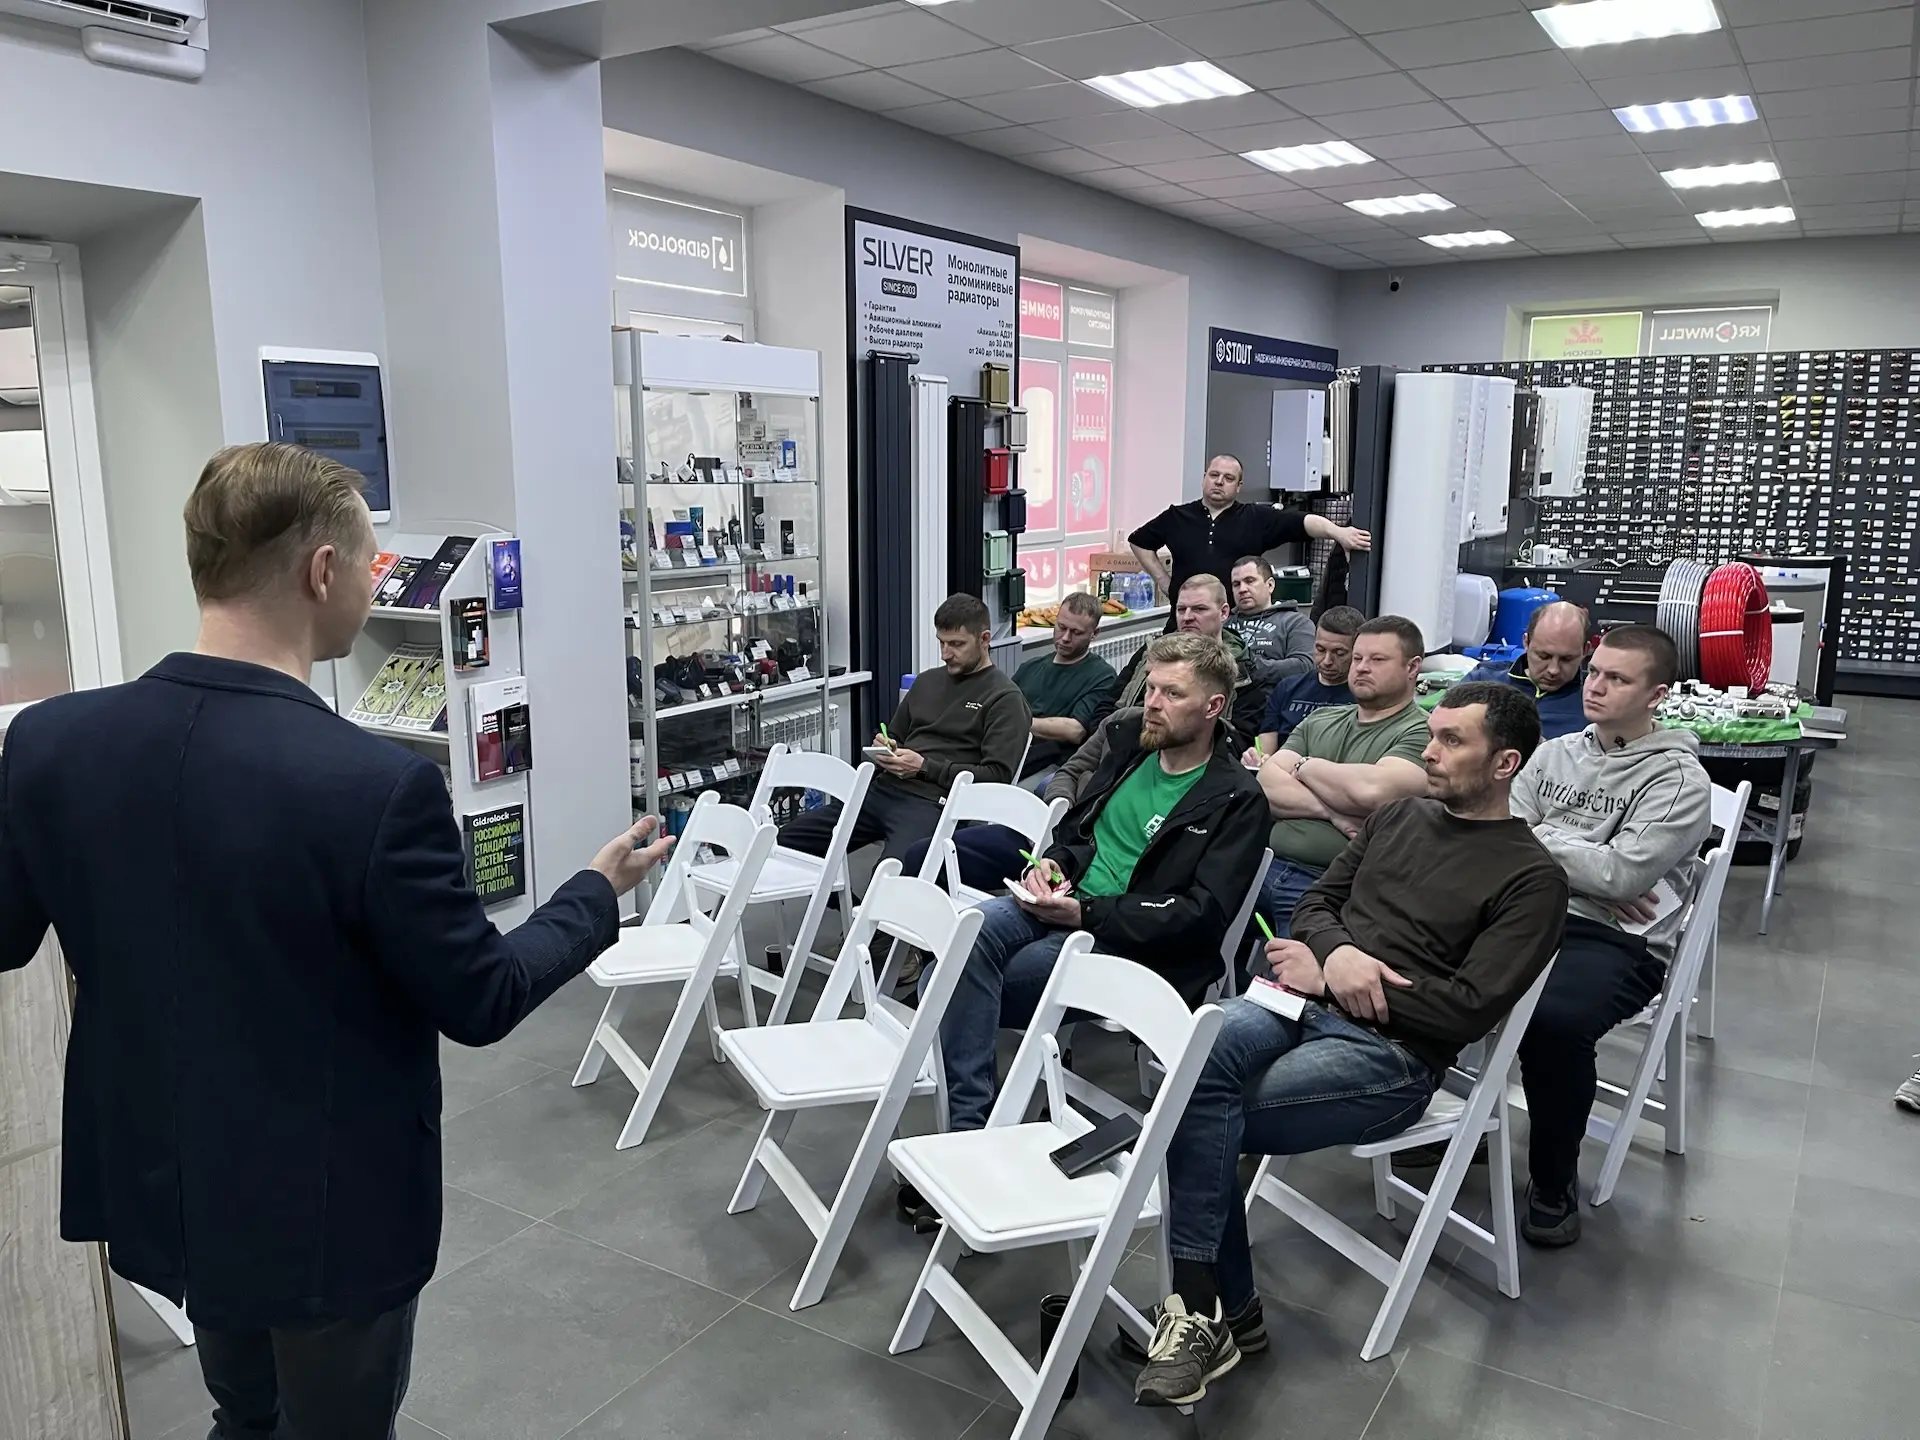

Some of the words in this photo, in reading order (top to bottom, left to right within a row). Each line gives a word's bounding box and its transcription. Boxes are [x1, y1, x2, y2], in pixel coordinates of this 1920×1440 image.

[862, 237, 933, 277] SILVER
[947, 253, 1008, 280] Монолитные
[882, 281, 902, 293] SINCE
[901, 283, 916, 296] 2003
[947, 273, 1014, 296] алюминиевые
[868, 301, 897, 314] Гарантия
[947, 289, 1000, 310] радиаторы
[868, 313, 911, 326] Авиационный
[911, 320, 942, 330] алюминий
[868, 325, 895, 335] Рабочее
[895, 329, 923, 339] давление
[869, 336, 892, 347] Высота
[892, 339, 923, 350] радиатора
[1225, 340, 1253, 366] STOUT
[472, 811, 510, 827] Gidrolock
[474, 818, 521, 843] РОССИЙСКИЙ
[474, 835, 512, 857] СТАНДАРТ
[474, 851, 504, 870] СИСТЕМ
[475, 863, 509, 883] ЗАЩИТЫ
[476, 884, 486, 897] ОТ
[486, 874, 515, 894] ПОТОПА
